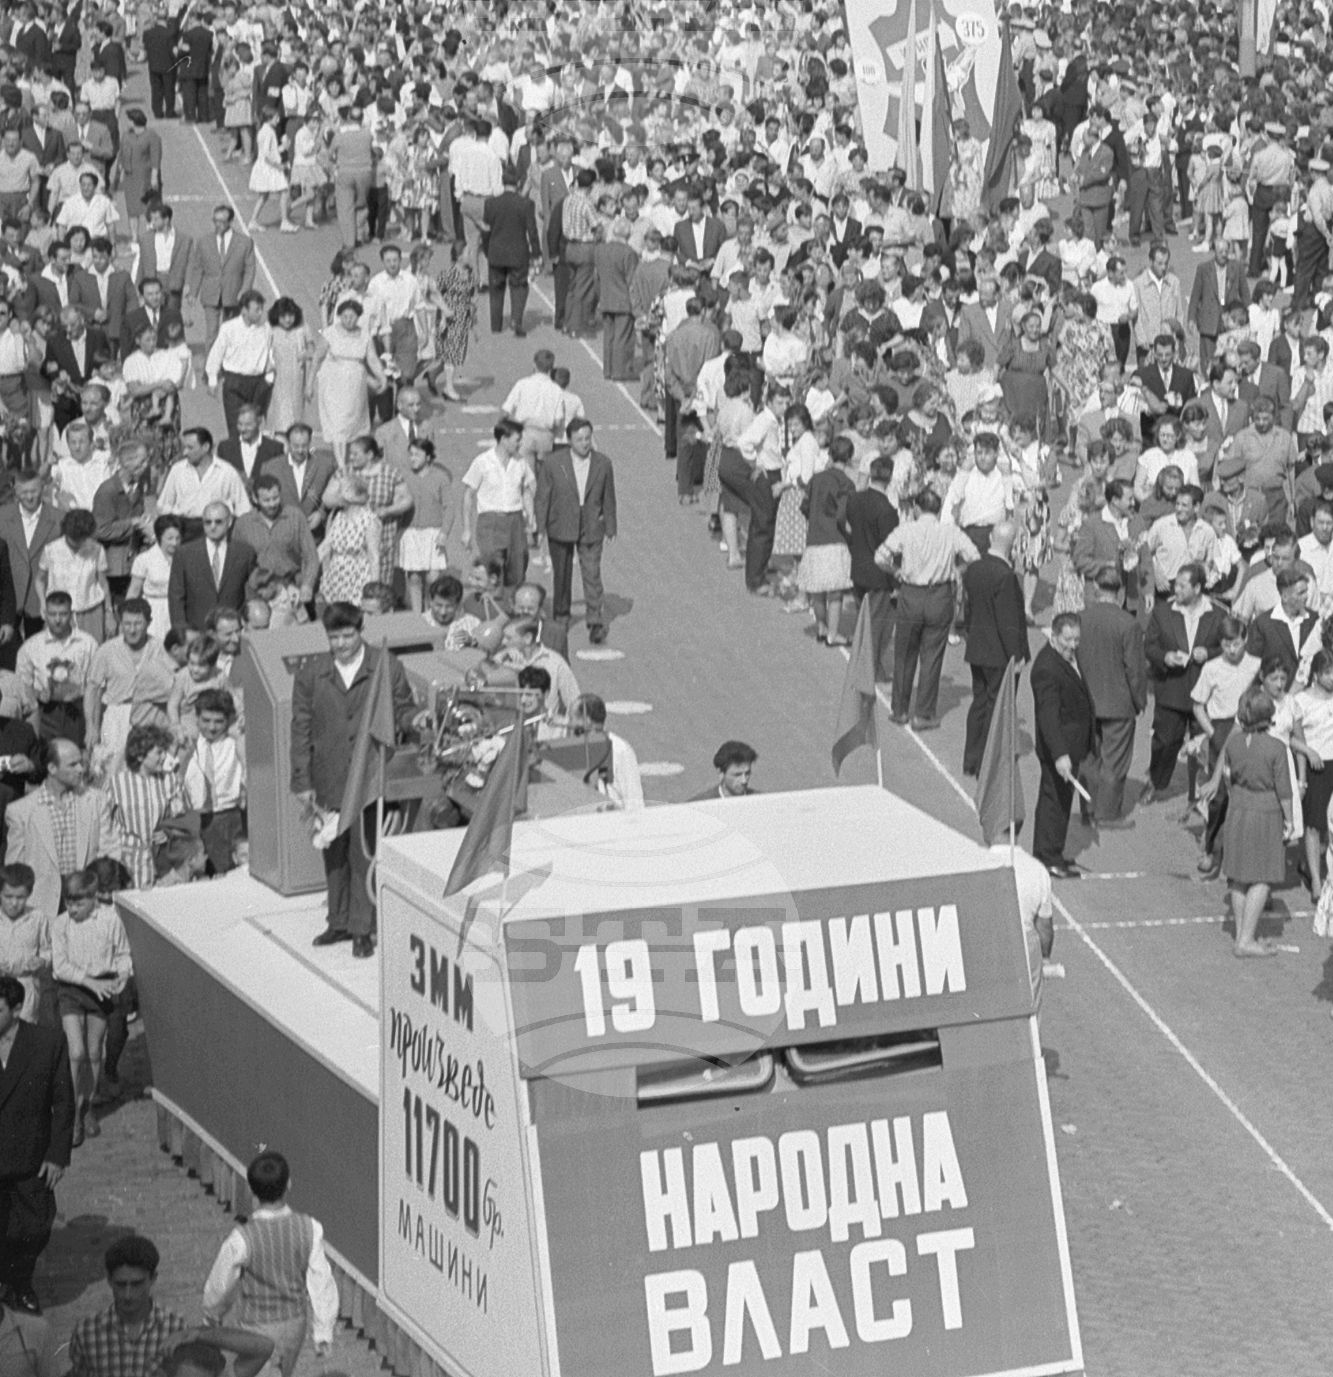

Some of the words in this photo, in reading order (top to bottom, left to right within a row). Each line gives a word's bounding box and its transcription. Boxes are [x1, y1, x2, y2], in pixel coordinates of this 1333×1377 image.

[409, 932, 474, 1033] ЗММ
[574, 938, 657, 1037] 19
[692, 903, 968, 1031] ГОДИНИ
[403, 1085, 481, 1239] 11700
[640, 1110, 969, 1253] НАРОДНА
[398, 1197, 488, 1315] МАШИНИ
[644, 1227, 976, 1377] ВЛАСТ
